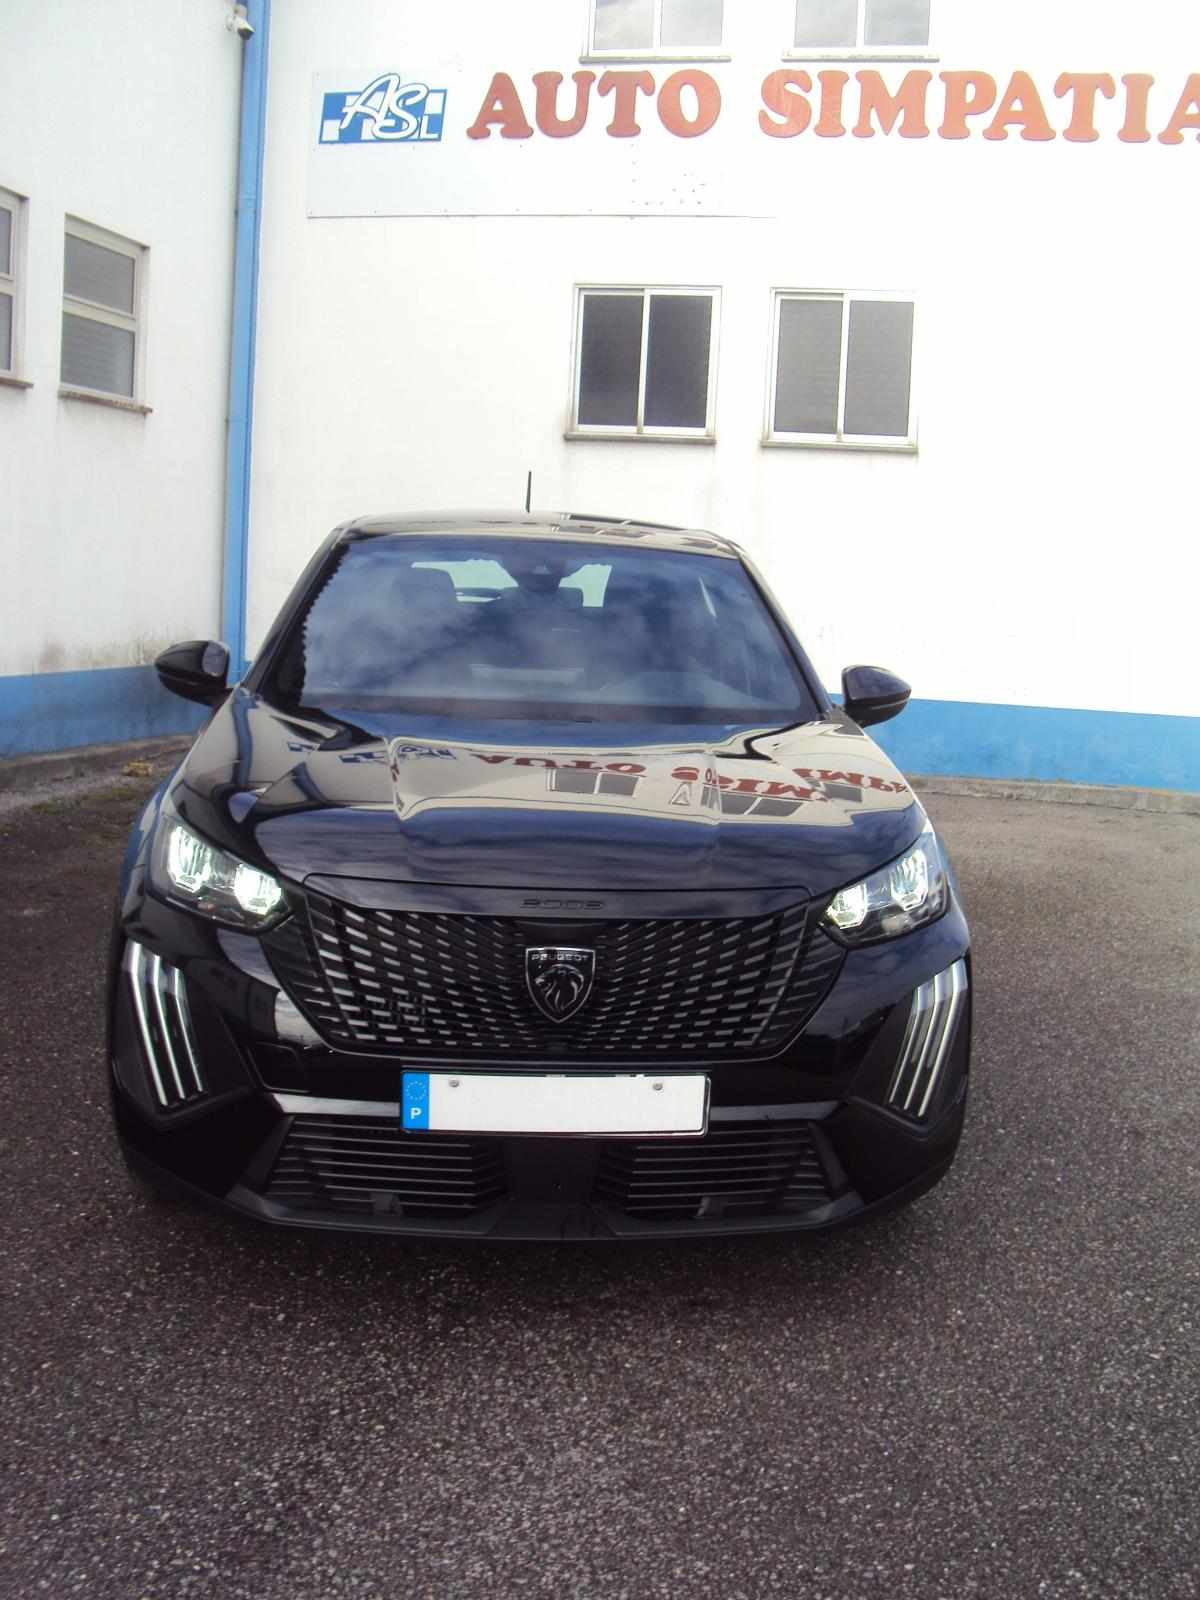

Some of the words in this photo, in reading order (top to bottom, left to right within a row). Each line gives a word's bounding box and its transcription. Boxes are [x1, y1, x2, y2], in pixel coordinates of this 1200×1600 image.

[466, 69, 722, 139] AUTO
[758, 69, 1200, 145] SIMPATIA
[410, 1107, 422, 1120] P
